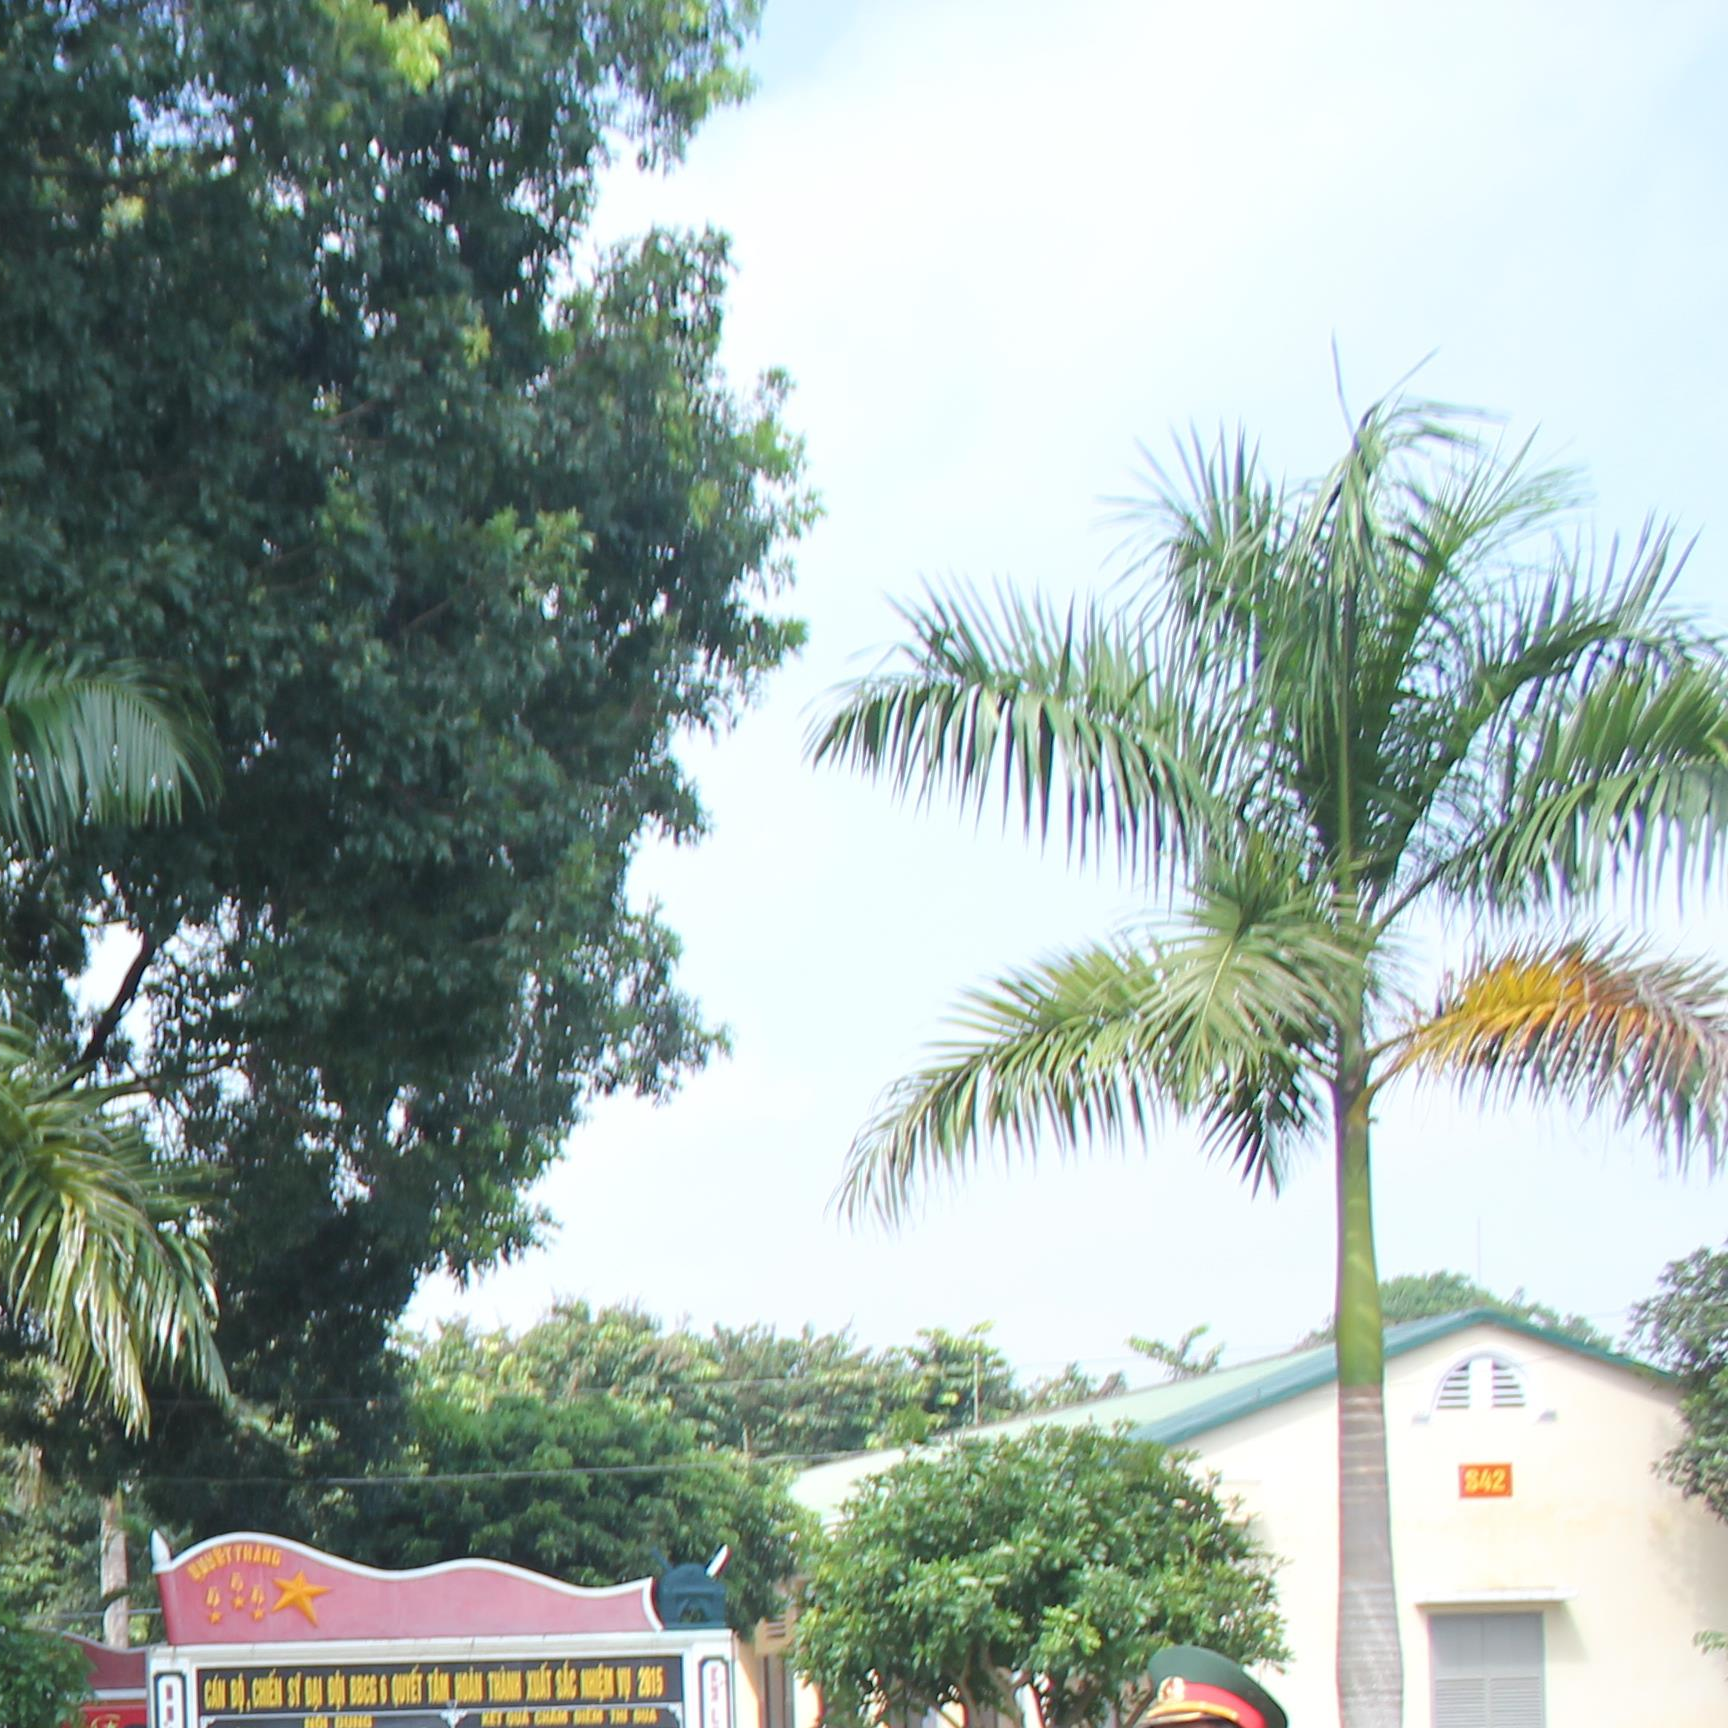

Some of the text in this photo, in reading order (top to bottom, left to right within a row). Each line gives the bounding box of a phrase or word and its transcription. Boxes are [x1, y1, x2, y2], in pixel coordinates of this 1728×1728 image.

[204, 1673, 226, 1710] CÁN
[251, 1668, 283, 1709] CHIẾN
[305, 1675, 323, 1711] ĐẠI
[327, 1669, 346, 1711] ĐỘI
[391, 1664, 423, 1708] QUYẾT
[427, 1667, 450, 1705] TÂM
[454, 1666, 483, 1703] HOÀN
[487, 1665, 522, 1702] THÀNH
[526, 1661, 552, 1701] XUẤT
[555, 1658, 577, 1701] SẮC
[580, 1662, 614, 1703] NHIỆM
[616, 1666, 632, 1702] VỤ
[637, 1665, 664, 1698] 2015
